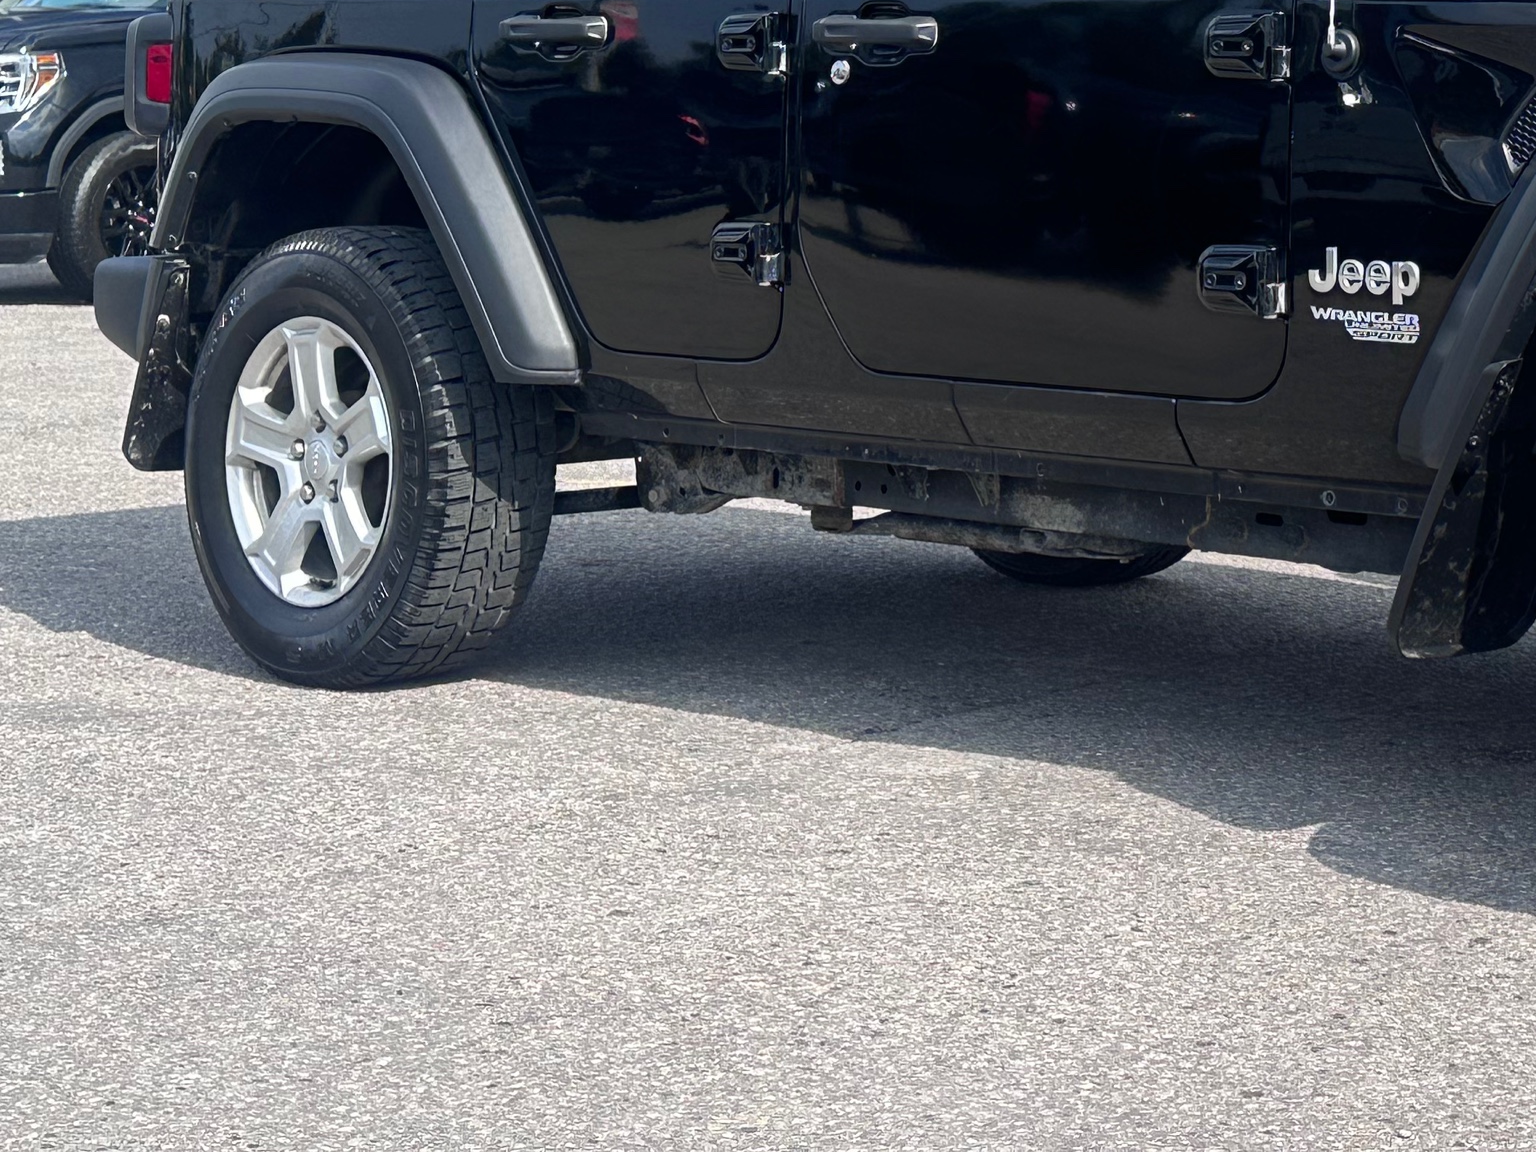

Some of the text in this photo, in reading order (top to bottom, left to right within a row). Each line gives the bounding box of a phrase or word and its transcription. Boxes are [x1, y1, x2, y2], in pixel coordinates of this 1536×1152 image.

[1308, 246, 1420, 305] Jeep
[1310, 305, 1419, 325] WRANGLER
[1350, 330, 1420, 344] SPORT
